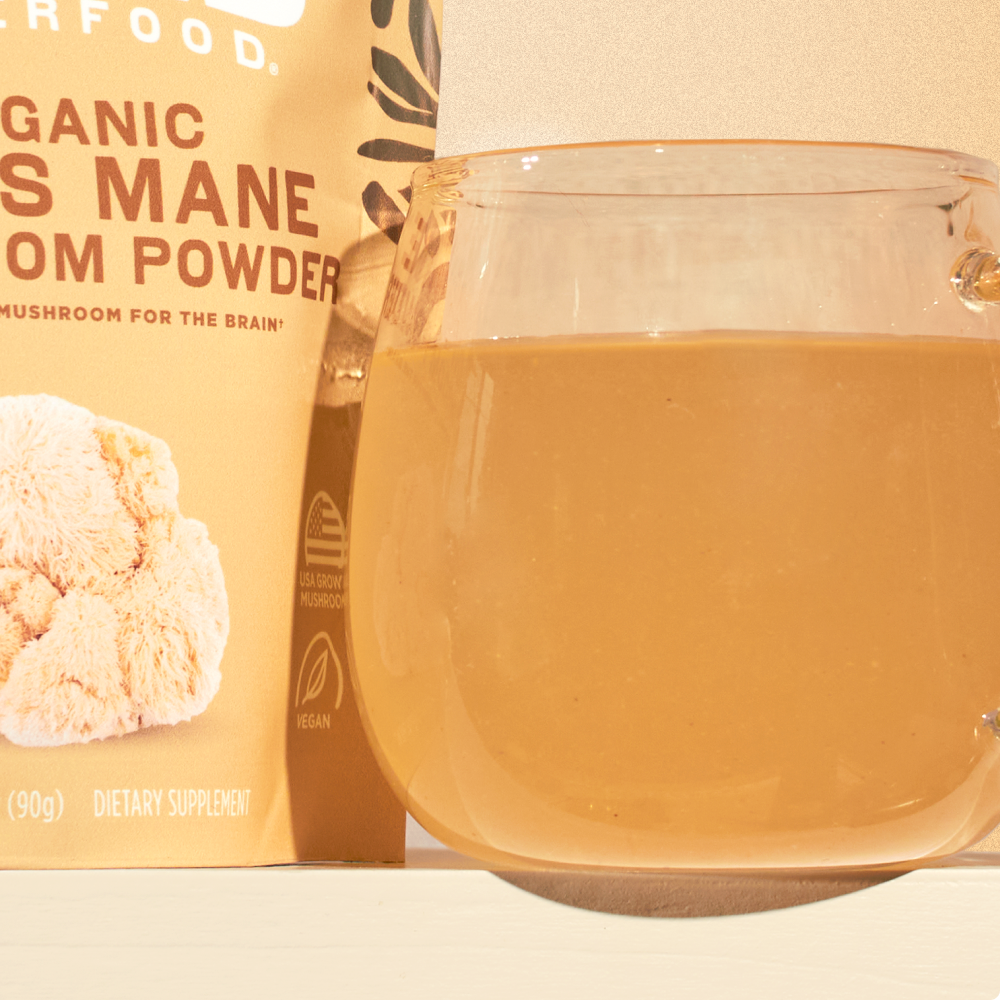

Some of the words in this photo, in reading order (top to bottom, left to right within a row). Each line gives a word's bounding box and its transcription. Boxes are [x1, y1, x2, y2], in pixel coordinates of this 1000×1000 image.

[94, 156, 319, 238] MANE
[133, 236, 341, 304] POWDER
[129, 307, 171, 325] FOR
[179, 310, 217, 327] THE
[300, 571, 316, 587] USA
[317, 573, 343, 590] GROW
[297, 713, 330, 730] VEGAN
[7, 789, 64, 823] (90g)
[93, 789, 163, 817] DIETARY
[168, 788, 251, 817] SUPPLEMENT
